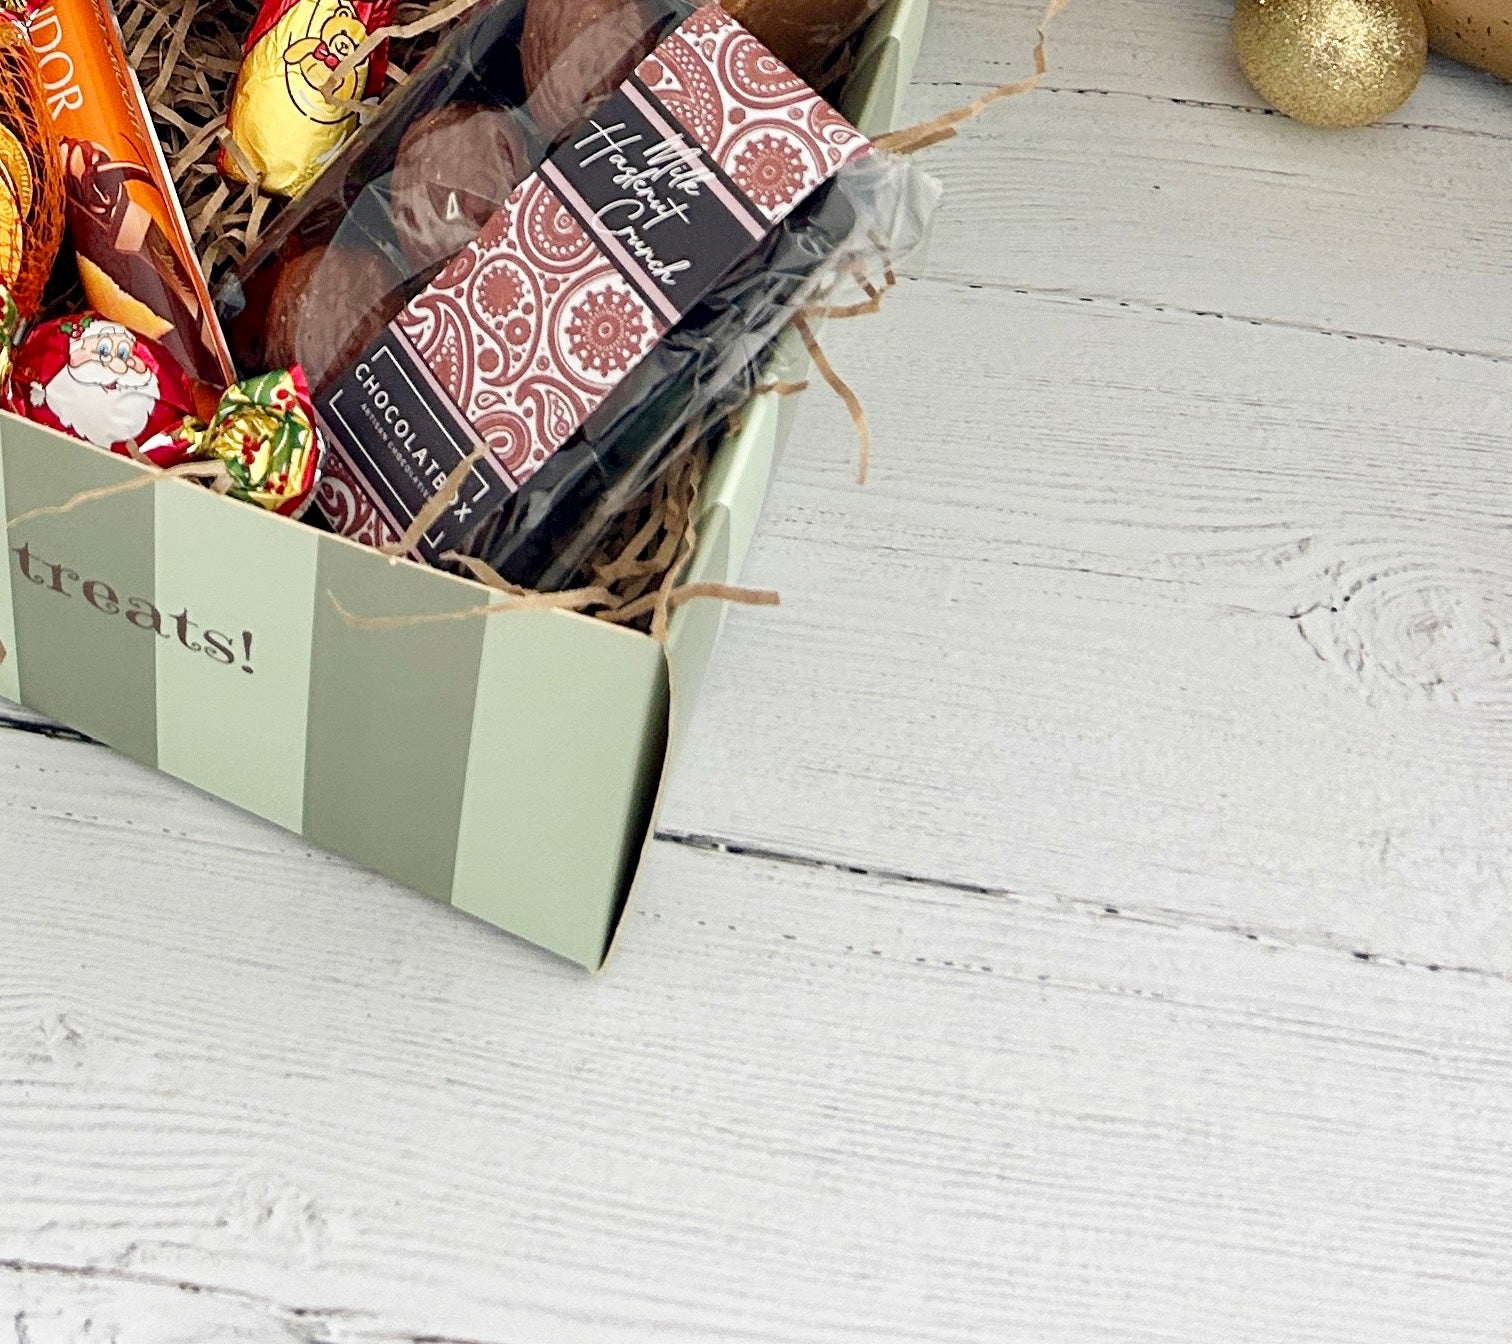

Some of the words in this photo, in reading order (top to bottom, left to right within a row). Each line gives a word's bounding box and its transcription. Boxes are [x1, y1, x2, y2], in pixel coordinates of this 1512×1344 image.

[643, 133, 717, 196] Milk
[592, 198, 691, 285] Crunch
[11, 541, 255, 674] treats!
